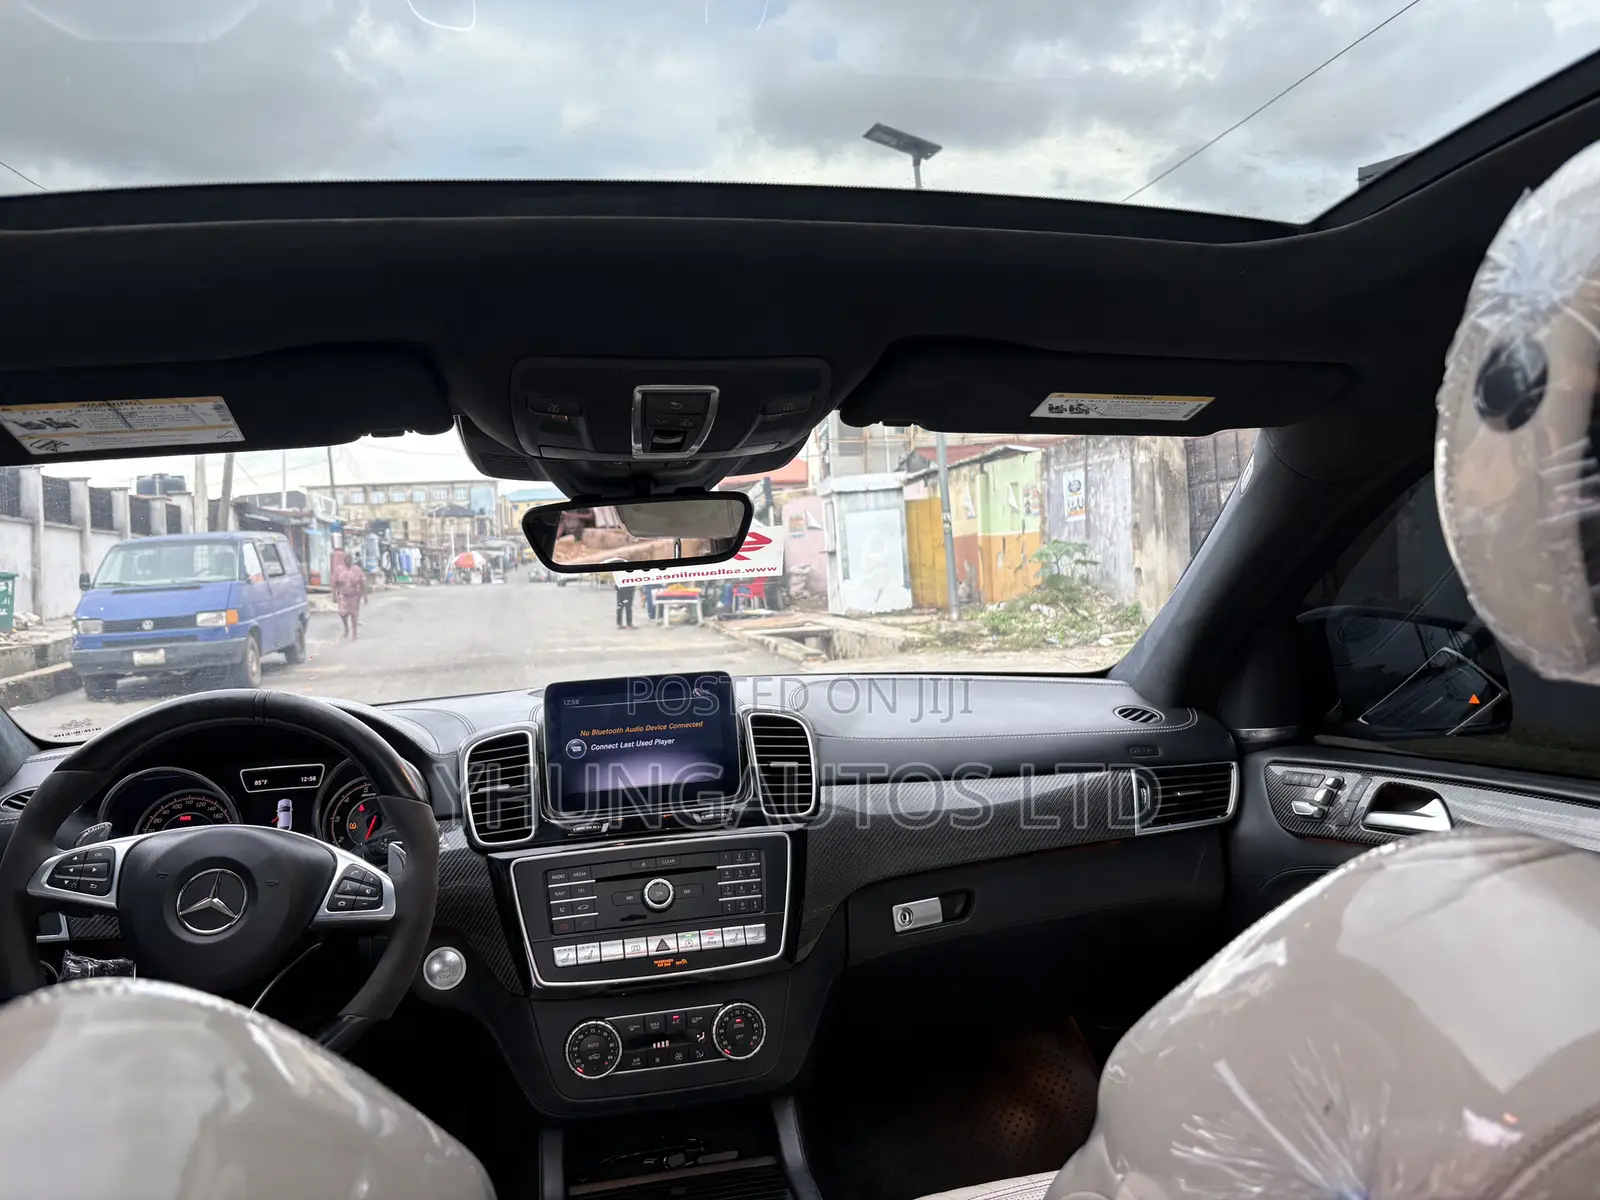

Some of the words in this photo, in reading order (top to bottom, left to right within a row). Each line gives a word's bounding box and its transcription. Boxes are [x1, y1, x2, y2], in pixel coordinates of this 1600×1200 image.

[579, 730, 590, 738] No
[591, 726, 624, 736] Bluetooth
[625, 724, 645, 733] Audio
[645, 723, 668, 732] Device
[668, 721, 703, 730] Connected
[591, 742, 619, 751] Connect
[620, 741, 635, 749] Last
[636, 739, 653, 748] Used
[654, 738, 675, 747] Player
